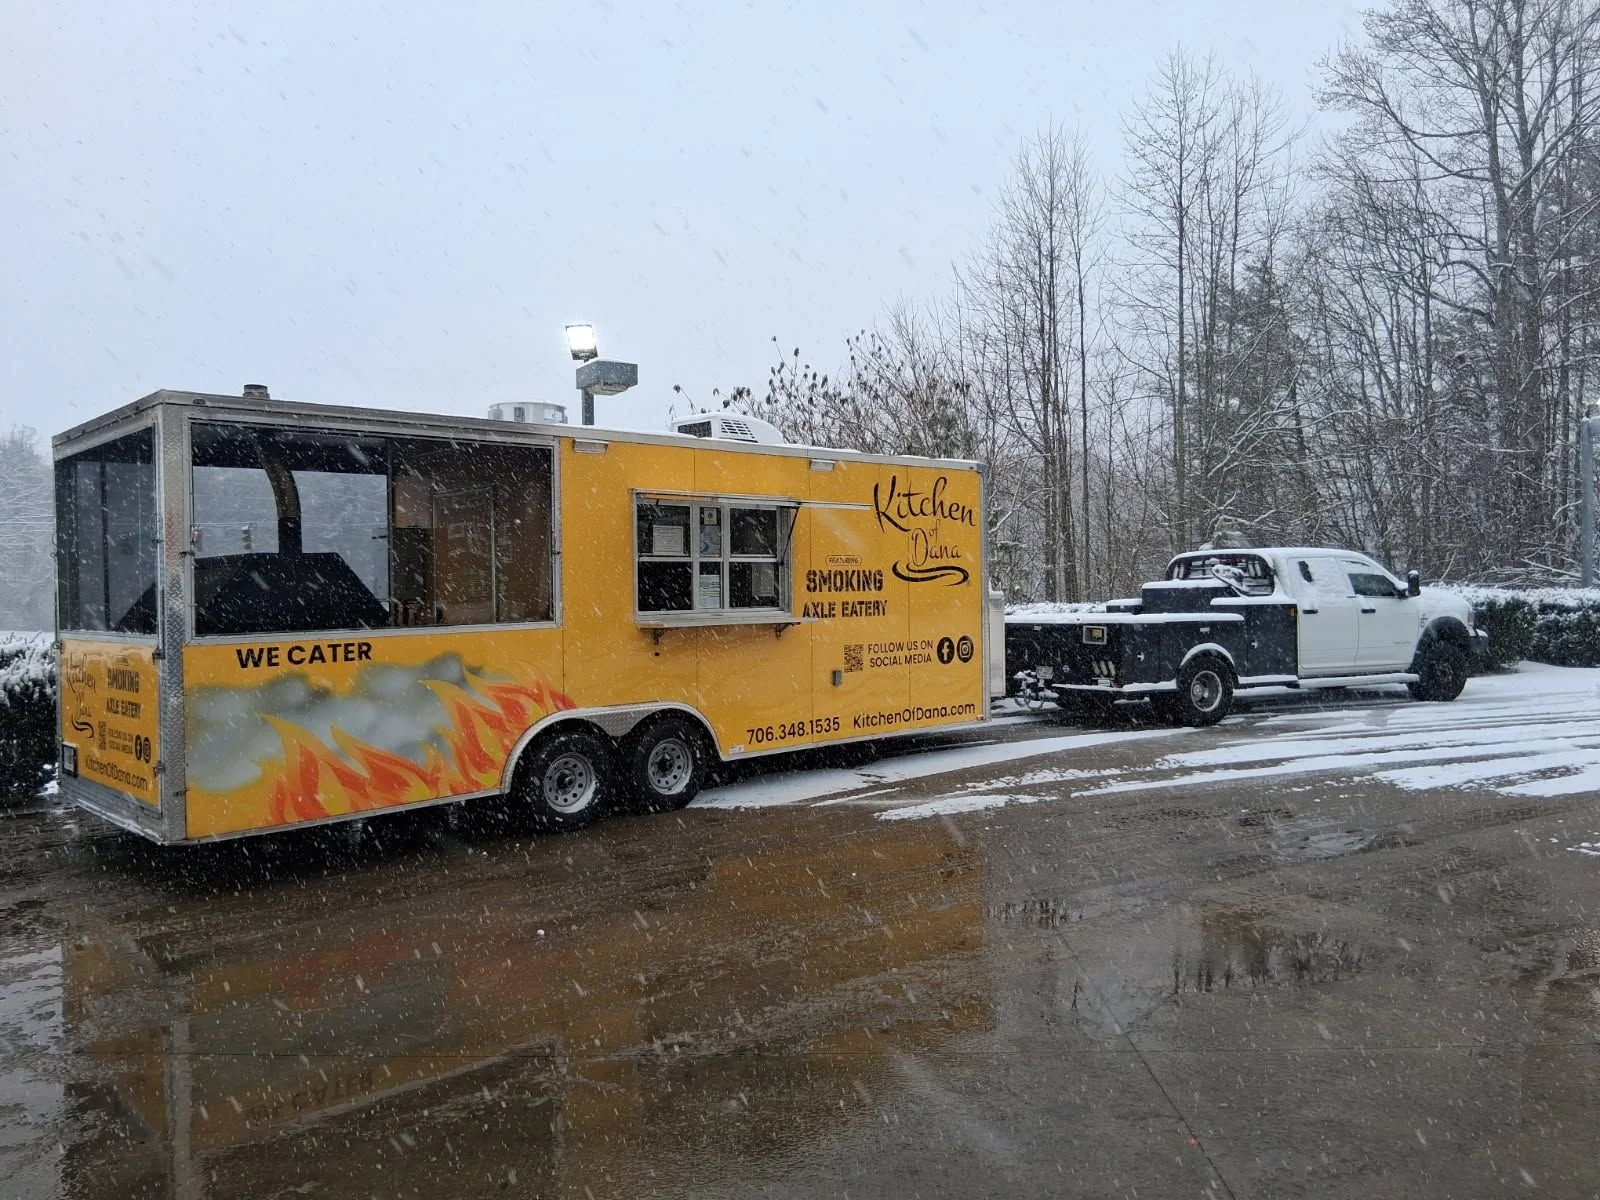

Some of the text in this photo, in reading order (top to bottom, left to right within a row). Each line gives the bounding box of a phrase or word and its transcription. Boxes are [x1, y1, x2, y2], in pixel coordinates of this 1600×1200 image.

[873, 475, 976, 534] Kitchen
[929, 519, 941, 541] of
[911, 527, 962, 567] Dana
[806, 569, 884, 593] SMOKING
[802, 599, 888, 619] AXLE EATERY
[236, 642, 373, 669] WE CATER
[868, 640, 933, 654] FOLLOW US ON
[870, 653, 933, 668] SOCIAL MEDIA
[853, 703, 976, 729] KitchenOfDana.com
[746, 717, 841, 744] 706.348.1535
